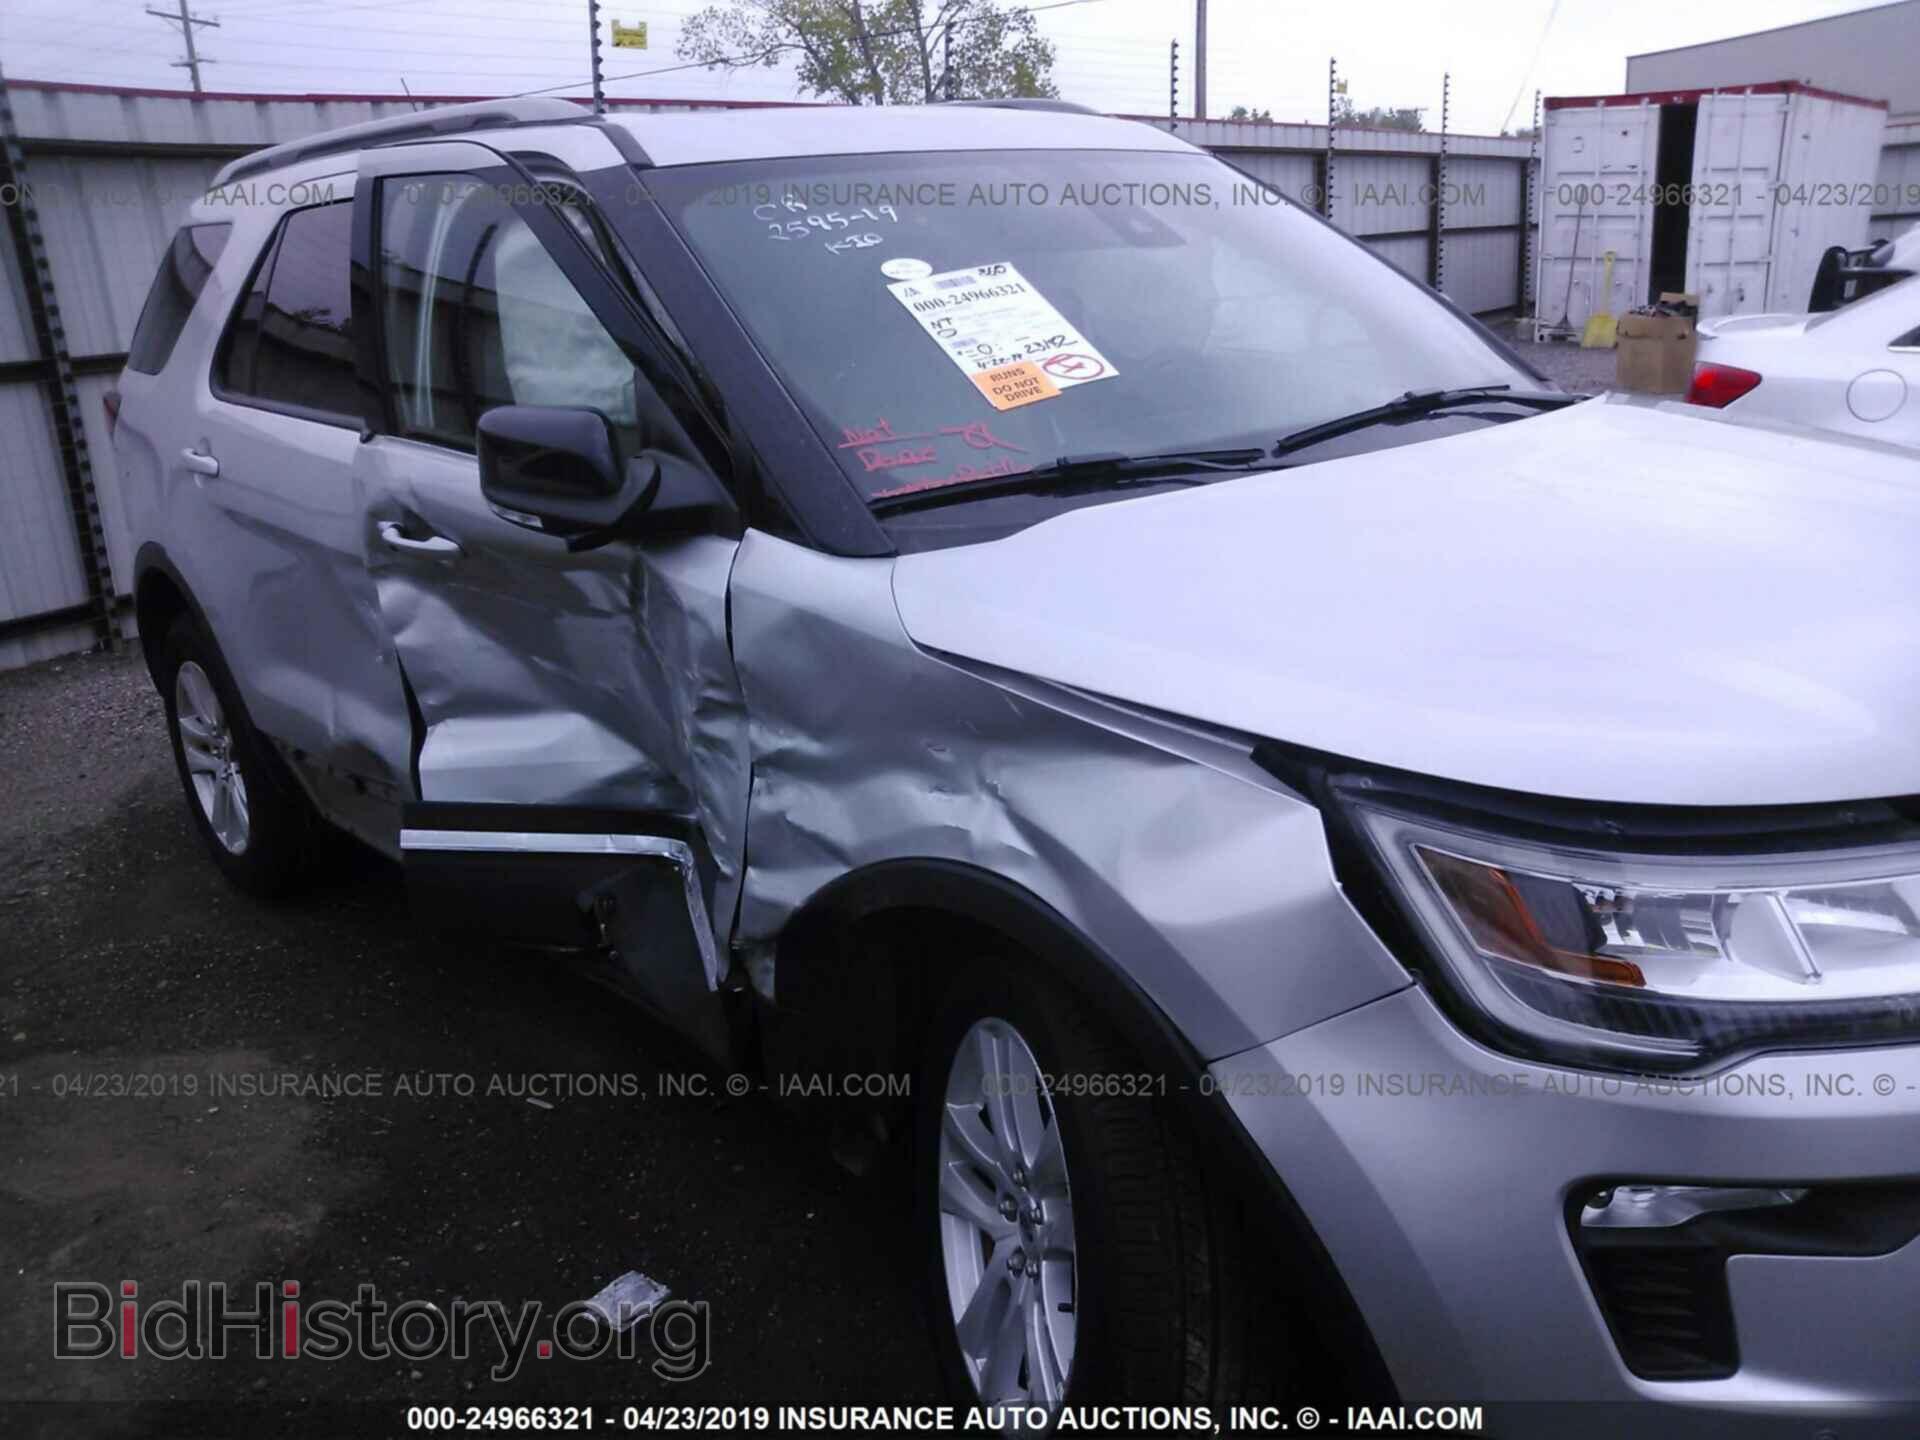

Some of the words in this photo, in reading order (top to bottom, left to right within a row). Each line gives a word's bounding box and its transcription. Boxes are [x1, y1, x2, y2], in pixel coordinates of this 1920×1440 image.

[990, 367, 1025, 382] RUNS
[992, 384, 1012, 395] DO
[1013, 376, 1040, 390] NOT
[1004, 385, 1043, 402] DRIVE
